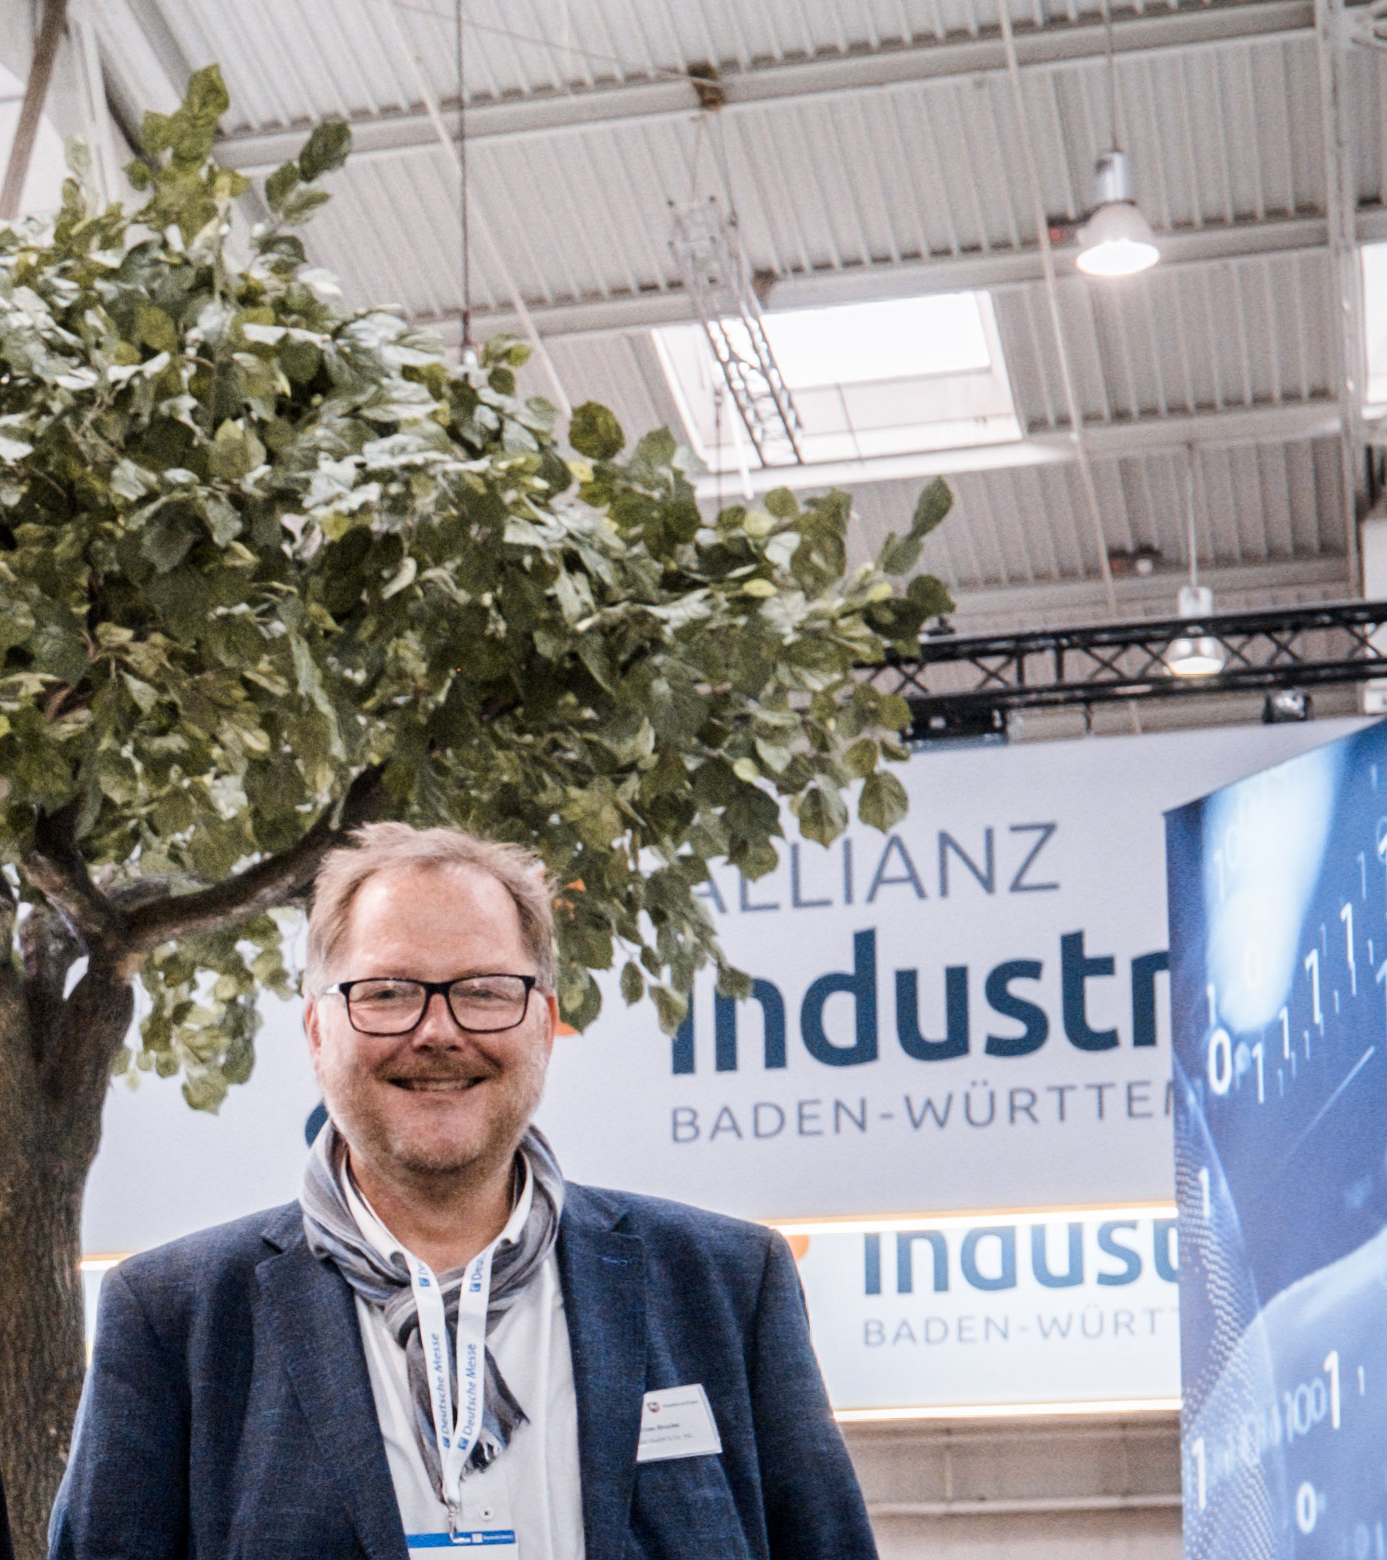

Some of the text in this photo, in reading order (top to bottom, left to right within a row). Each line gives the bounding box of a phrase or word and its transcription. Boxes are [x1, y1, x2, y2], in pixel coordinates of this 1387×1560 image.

[863, 1303, 1178, 1348] BADEN-WÜRT
[431, 1332, 444, 1373] Messe
[462, 1343, 477, 1437] Deutsche Messe
